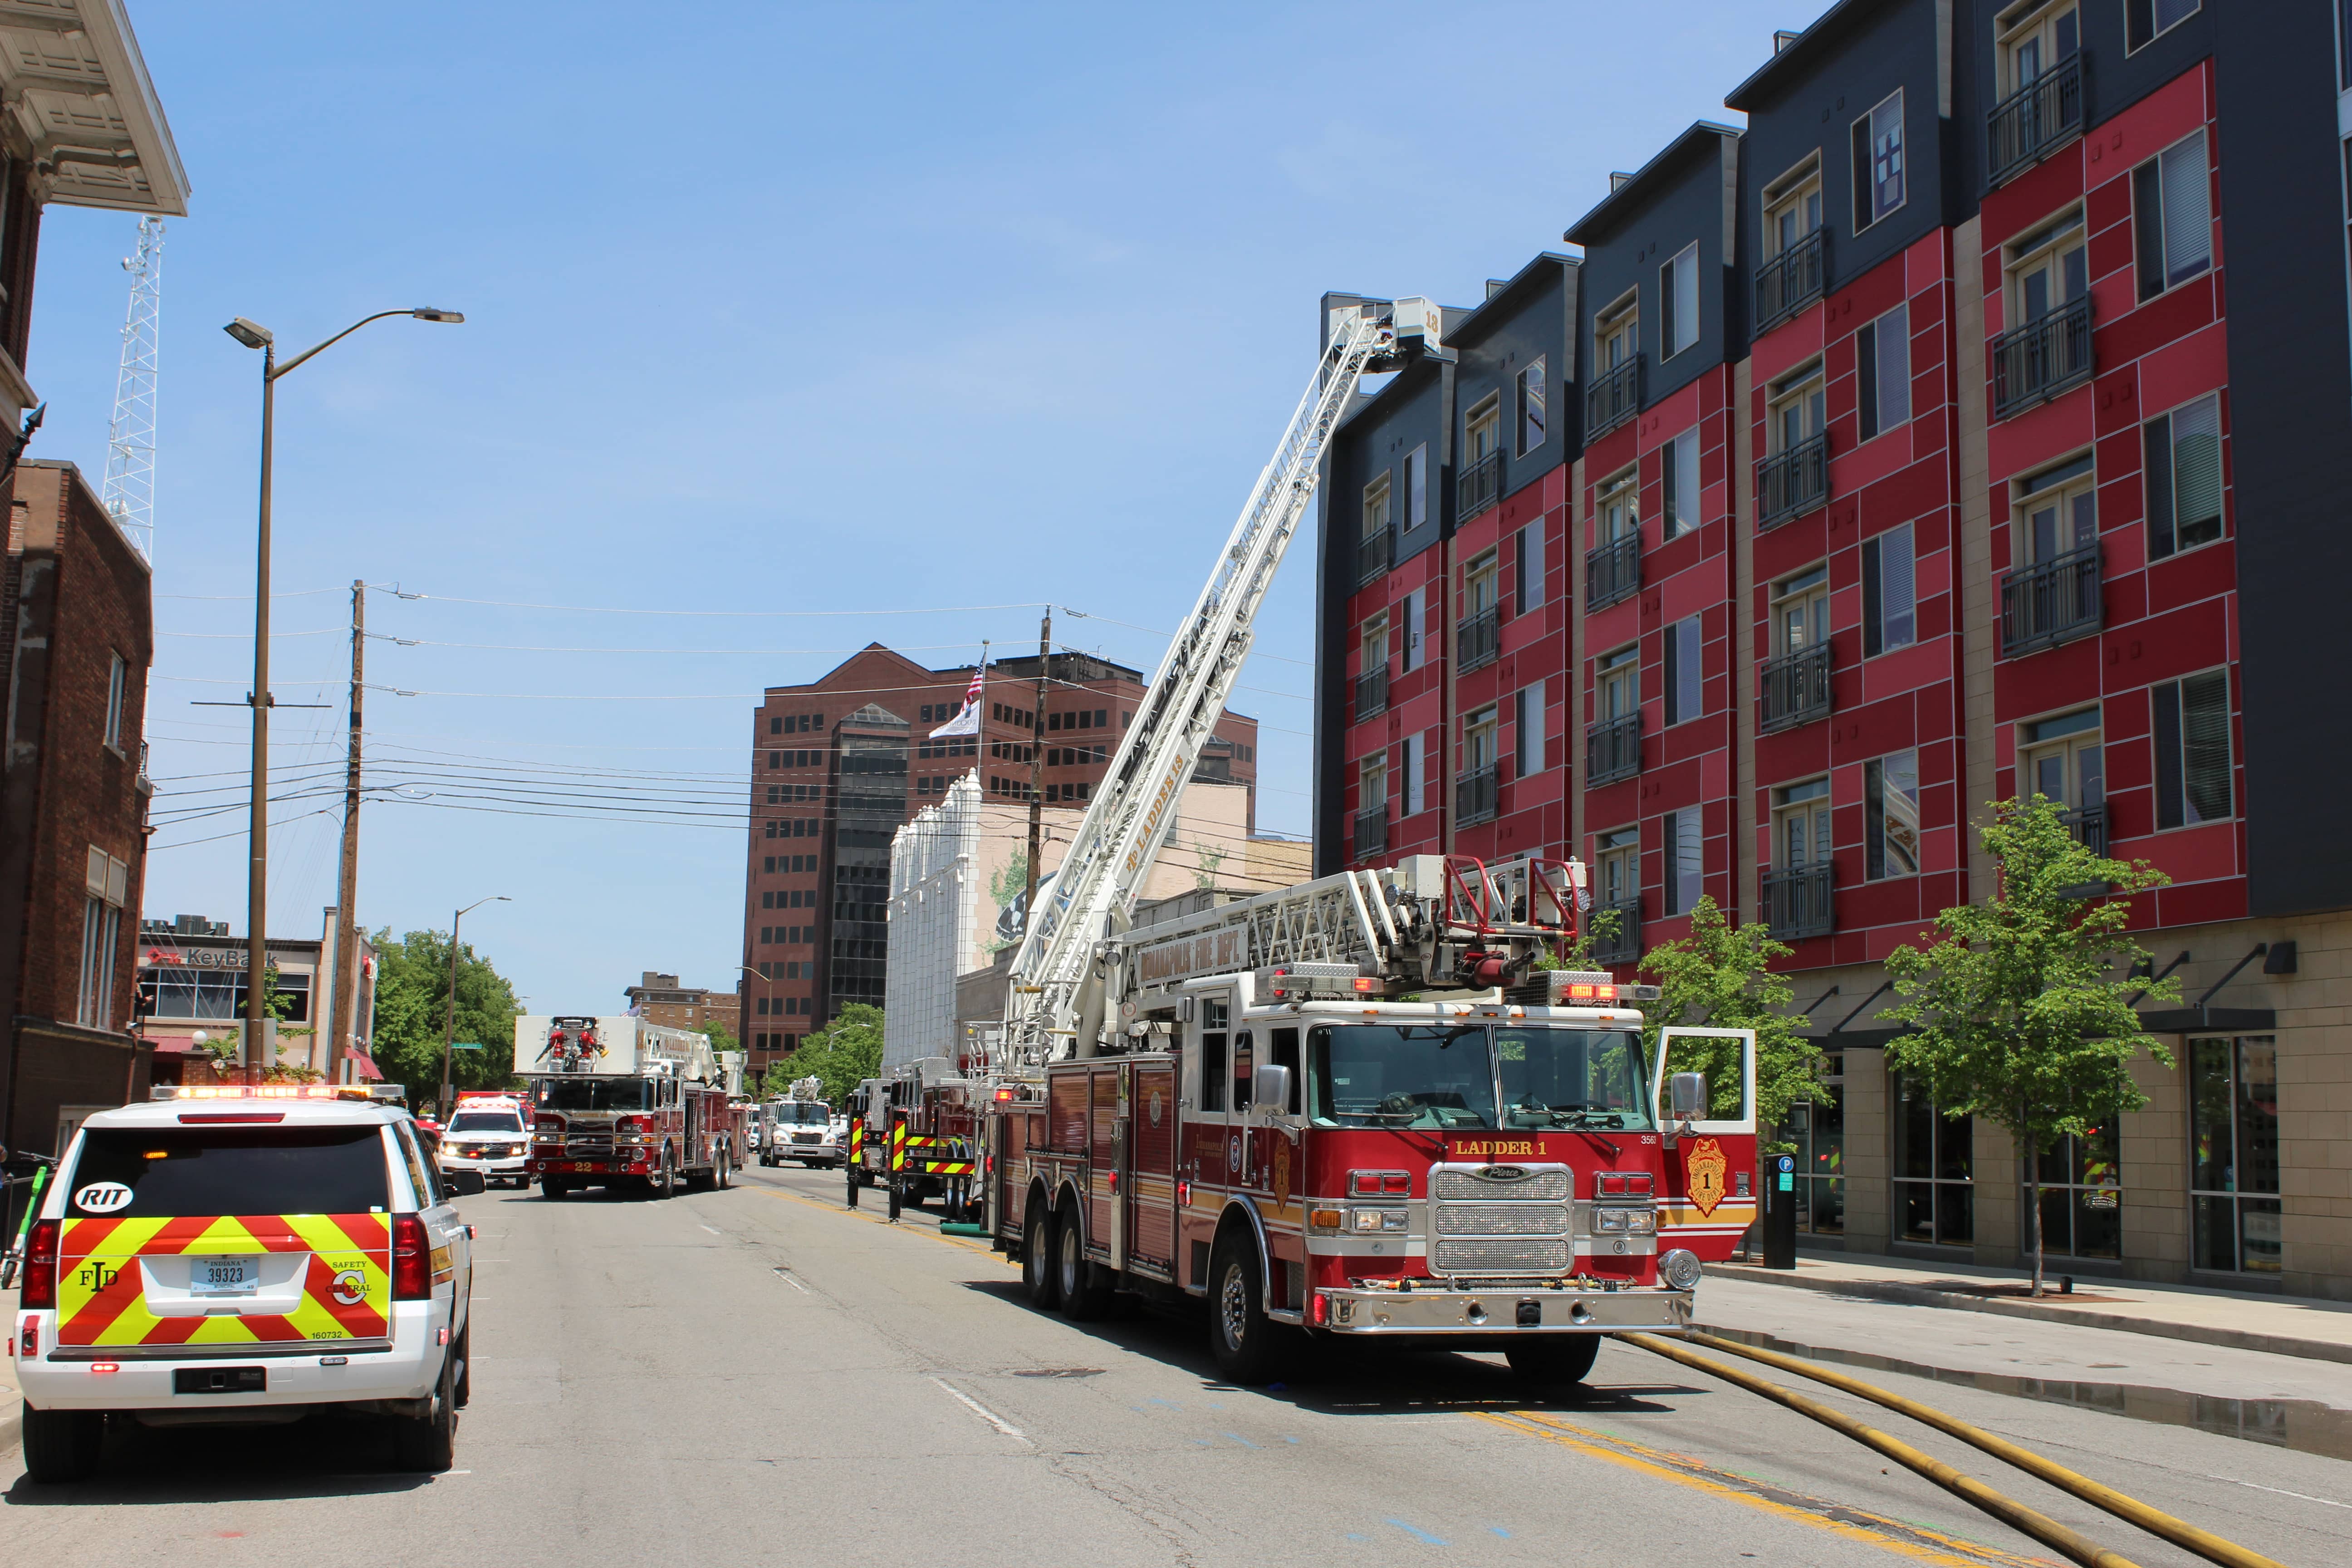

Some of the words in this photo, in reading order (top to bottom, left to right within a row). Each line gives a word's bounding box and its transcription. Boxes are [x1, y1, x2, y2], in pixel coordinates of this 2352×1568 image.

[1426, 310, 1438, 333] 13
[1136, 774, 1174, 852] LADDER
[1172, 754, 1183, 778] 13
[187, 948, 278, 969] KeyBak
[1141, 941, 1191, 982] INDIANAPOLIS
[1196, 936, 1213, 970] FIRE
[1217, 930, 1240, 965] DEPT.
[1455, 1141, 1534, 1155] LADDER
[1539, 1142, 1547, 1155] 1
[574, 1162, 592, 1172] 22
[1489, 1167, 1519, 1177] Pierce
[1692, 1161, 1722, 1180] INDIANAPOLIS
[1784, 1159, 1791, 1170] P
[1703, 1173, 1710, 1189] 1
[80, 1189, 128, 1205] RIT
[1694, 1187, 1706, 1201] FIRE
[1707, 1187, 1721, 1201] DEPT.
[208, 1267, 243, 1282] 39323
[325, 1284, 372, 1293] CENTRAL
[312, 1331, 342, 1339] 160732
